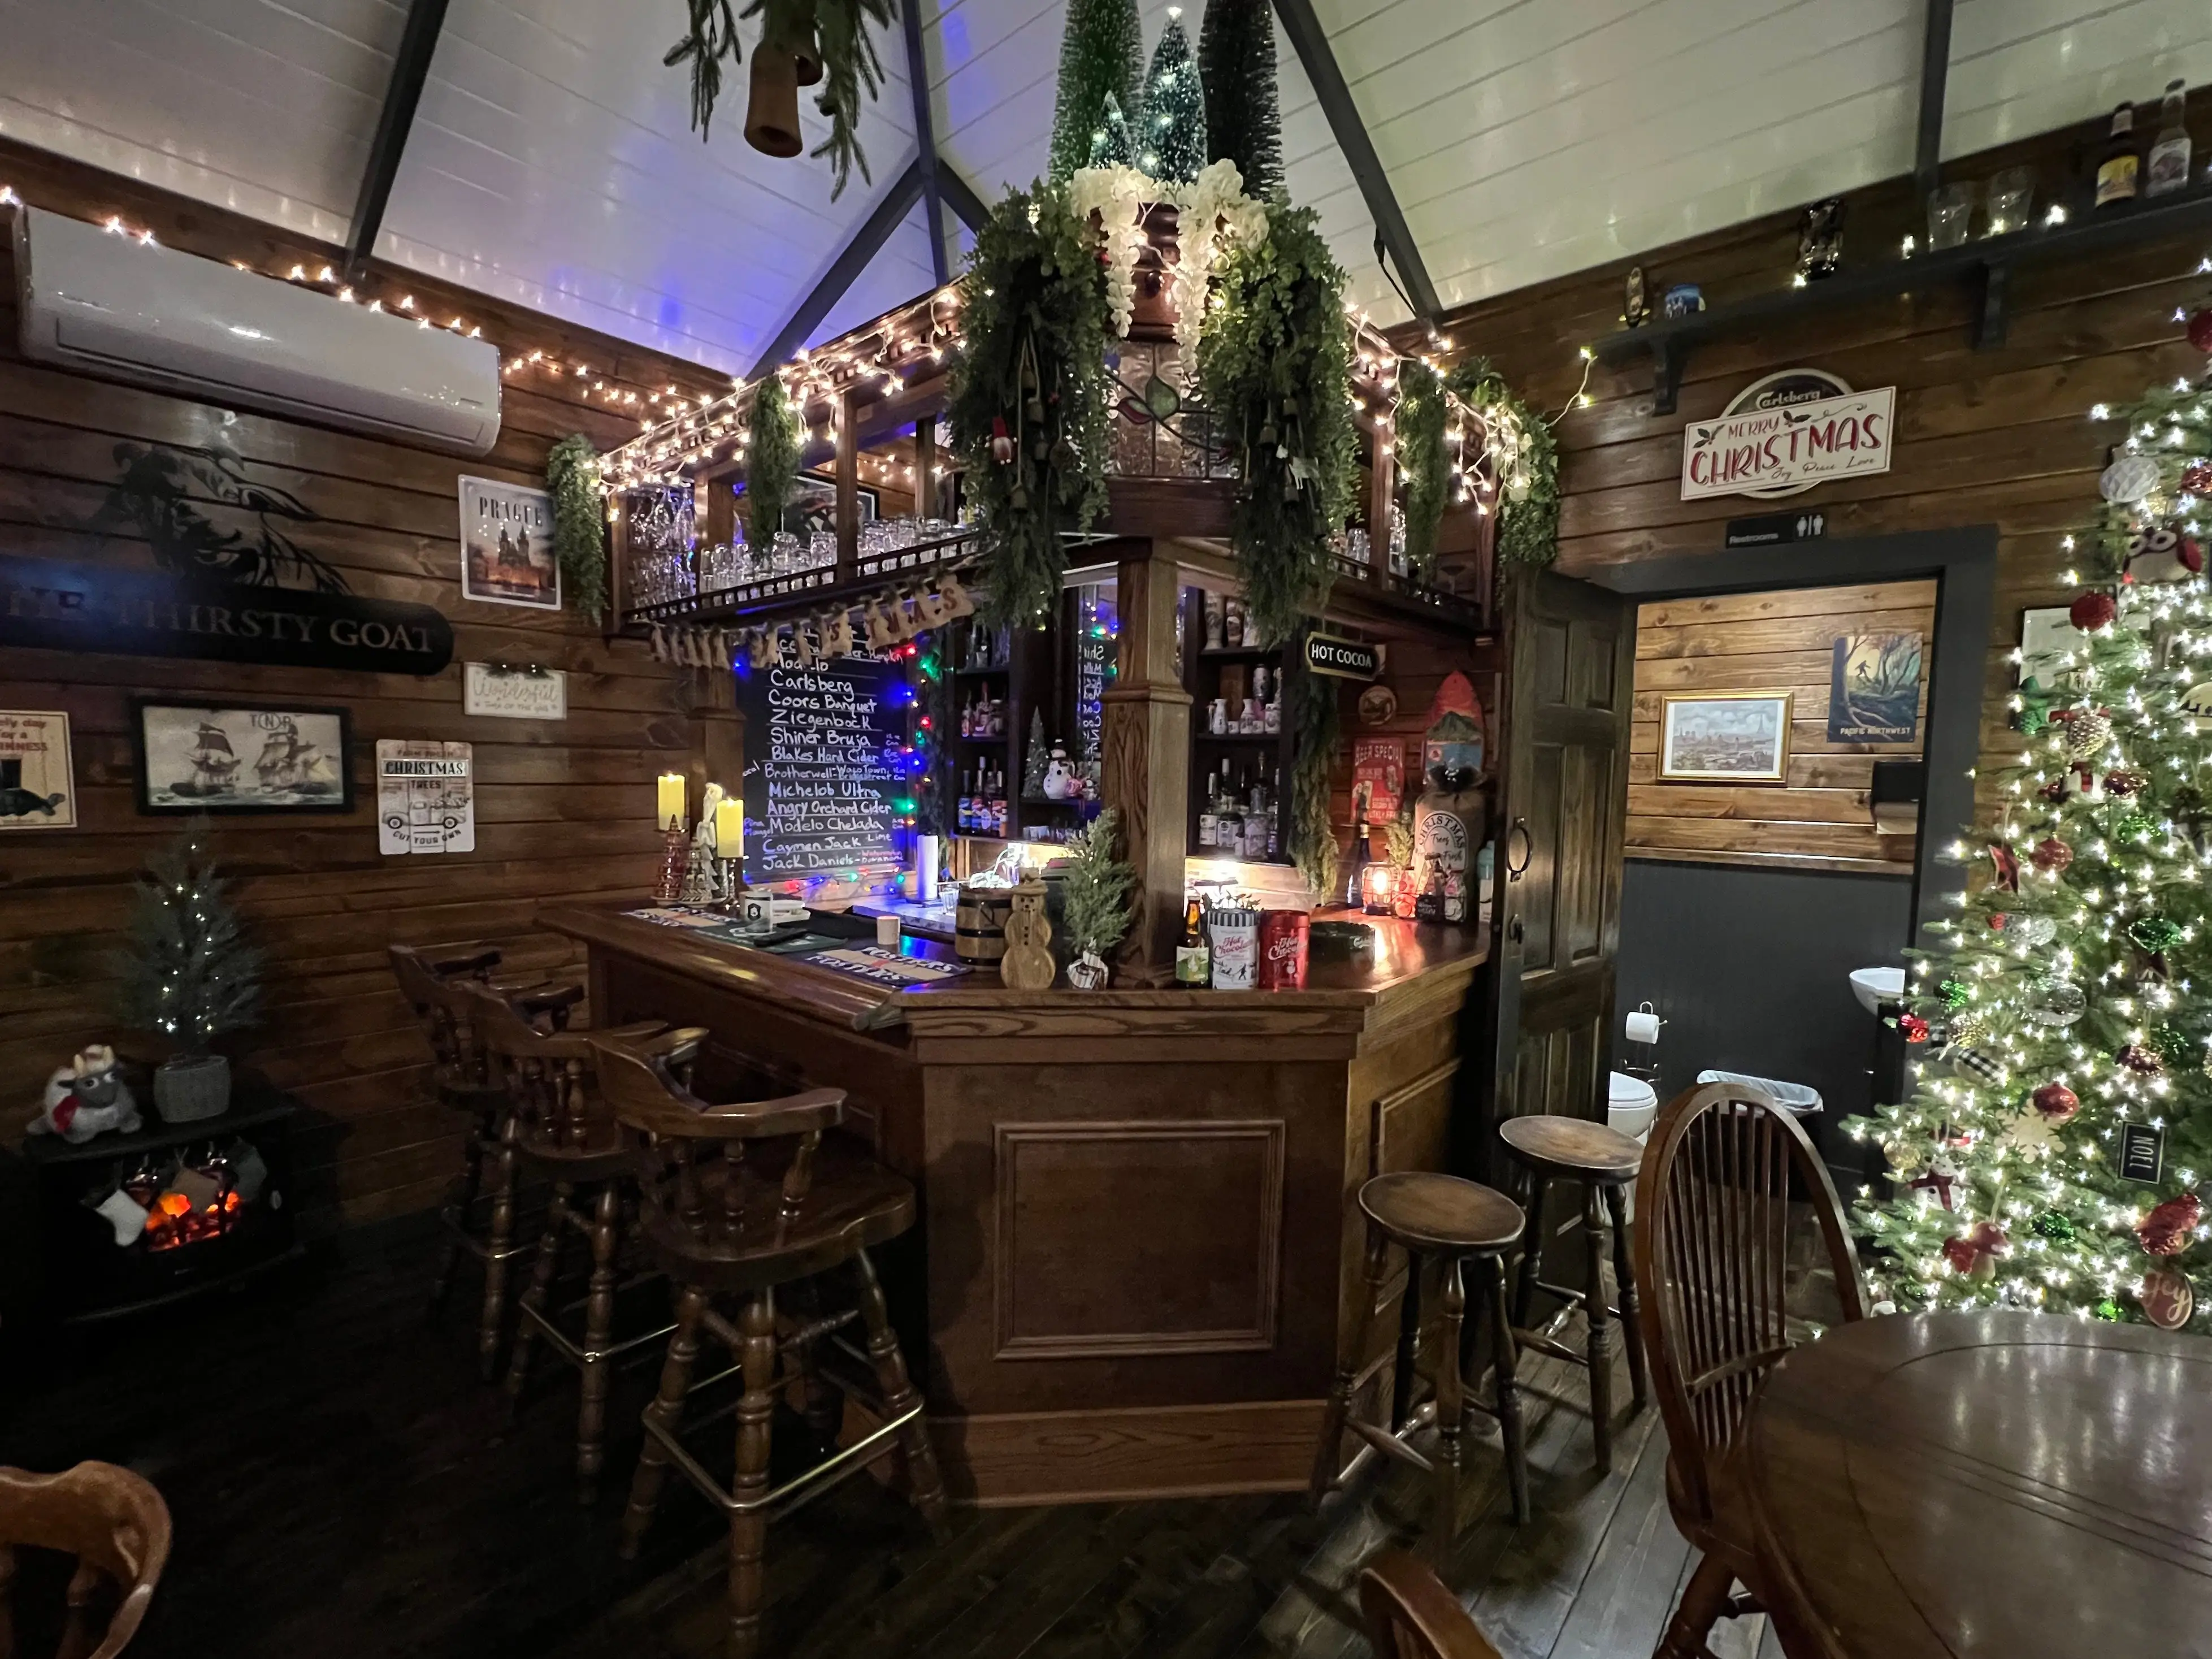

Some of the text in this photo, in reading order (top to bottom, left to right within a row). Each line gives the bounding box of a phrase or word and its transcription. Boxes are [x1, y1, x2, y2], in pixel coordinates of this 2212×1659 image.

[1756, 391, 1821, 410] Carlsberg
[1728, 416, 1780, 440] MERRY
[1690, 413, 1884, 486] CHRISTMAS
[1771, 456, 1876, 481] Joy Peace Love
[479, 496, 543, 527] PRAGUE
[1729, 533, 1779, 545] Restrooms
[115, 598, 321, 643] THIRSTY
[329, 619, 434, 653] GOAT
[1311, 643, 1372, 668] HOT COCOA
[770, 669, 855, 701] Carlsberg
[769, 688, 878, 718] Coors Banquet
[770, 726, 821, 745] Shiner
[827, 730, 871, 751] Bruja
[1840, 726, 1911, 737] PACIFIC NORTHWEST
[817, 747, 845, 763] Hard
[848, 751, 879, 764] Cider
[1355, 744, 1403, 769] BEER SPECIAL
[385, 761, 463, 775] CHRISTMAS
[411, 780, 441, 789] TREES
[769, 781, 882, 798] Michelob Ultra
[767, 800, 892, 821] Angry Orchard Cider
[393, 830, 410, 842] CUT
[441, 829, 462, 842] OWN
[769, 817, 825, 834] Modelo
[827, 816, 884, 831] Chelada
[1419, 815, 1466, 846] CHRISTMAS
[825, 836, 861, 850] Jack
[868, 833, 893, 842] Lime
[1430, 832, 1450, 846] Trees
[762, 855, 805, 870] Jack
[2129, 1134, 2155, 1169] NOEL
